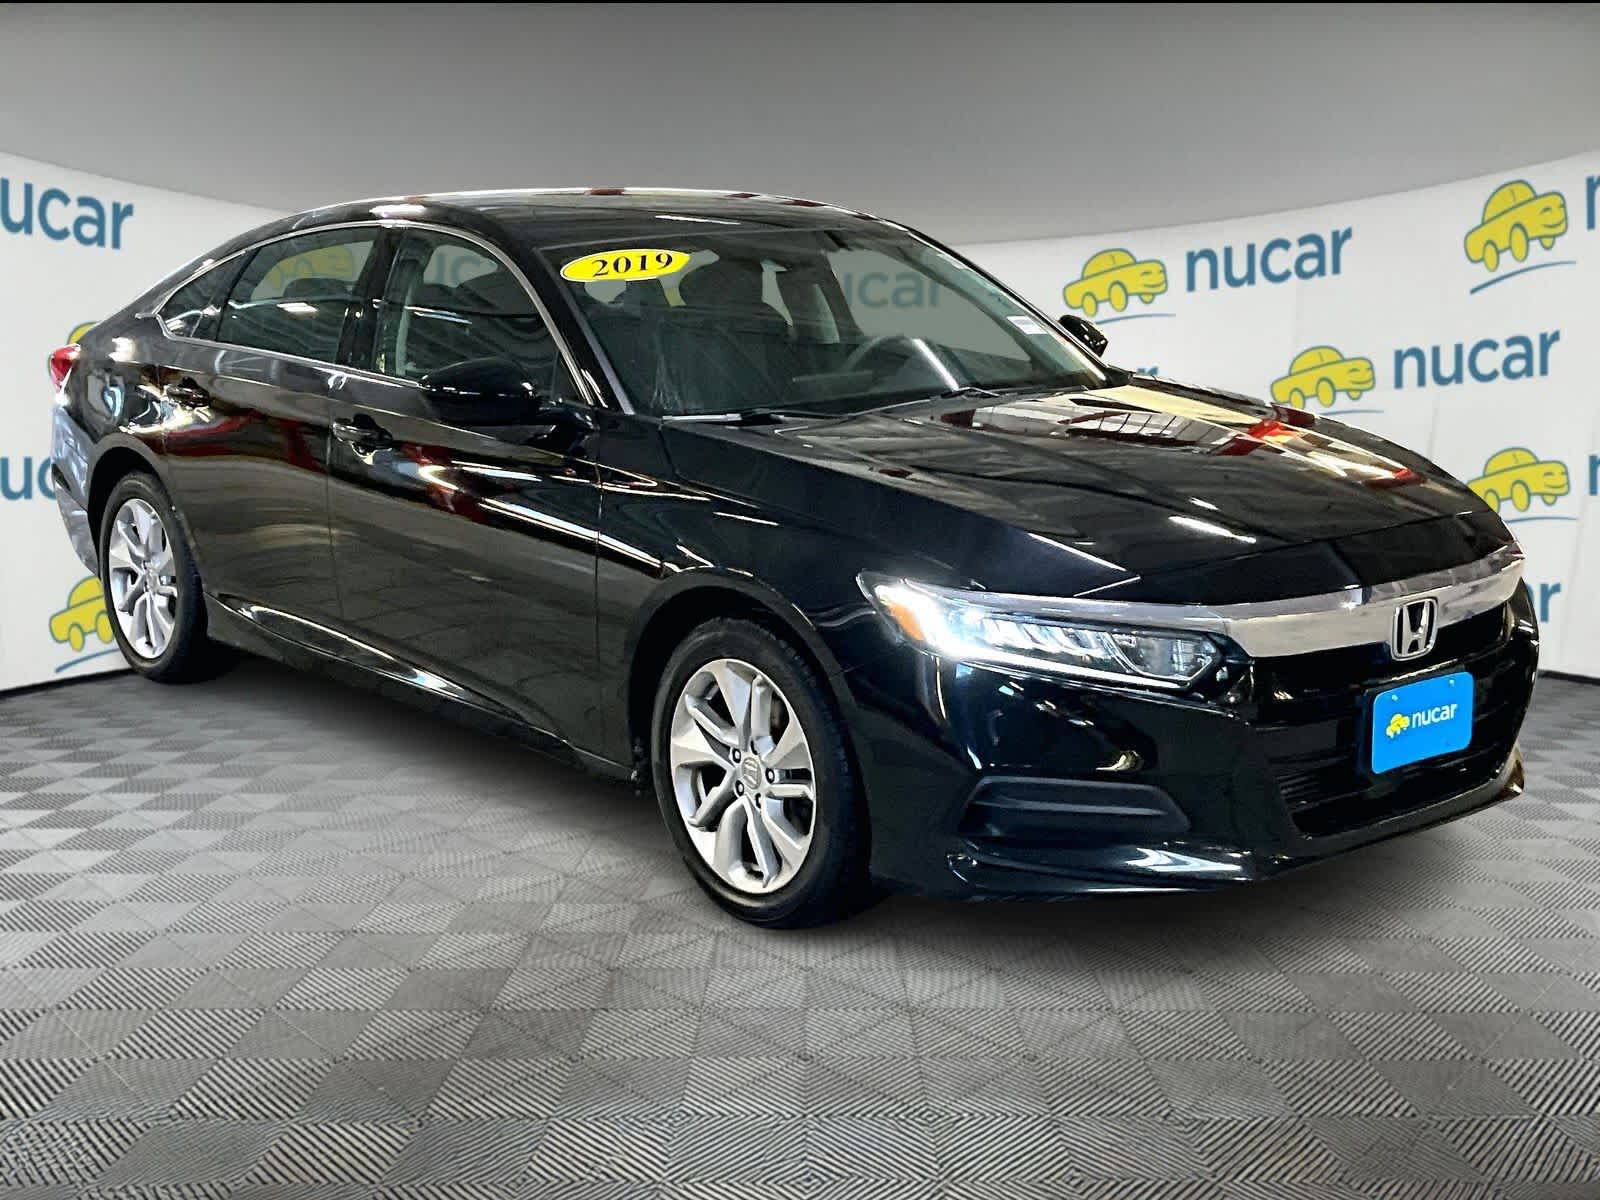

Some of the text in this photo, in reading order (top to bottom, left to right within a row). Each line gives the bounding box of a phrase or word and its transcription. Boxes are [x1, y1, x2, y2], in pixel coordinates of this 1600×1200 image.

[0, 177, 134, 250] ucar
[591, 253, 673, 277] 2019
[1186, 226, 1353, 292] nucar
[843, 271, 939, 309] car
[1393, 330, 1561, 389] nucar
[1411, 703, 1458, 729] nucar
